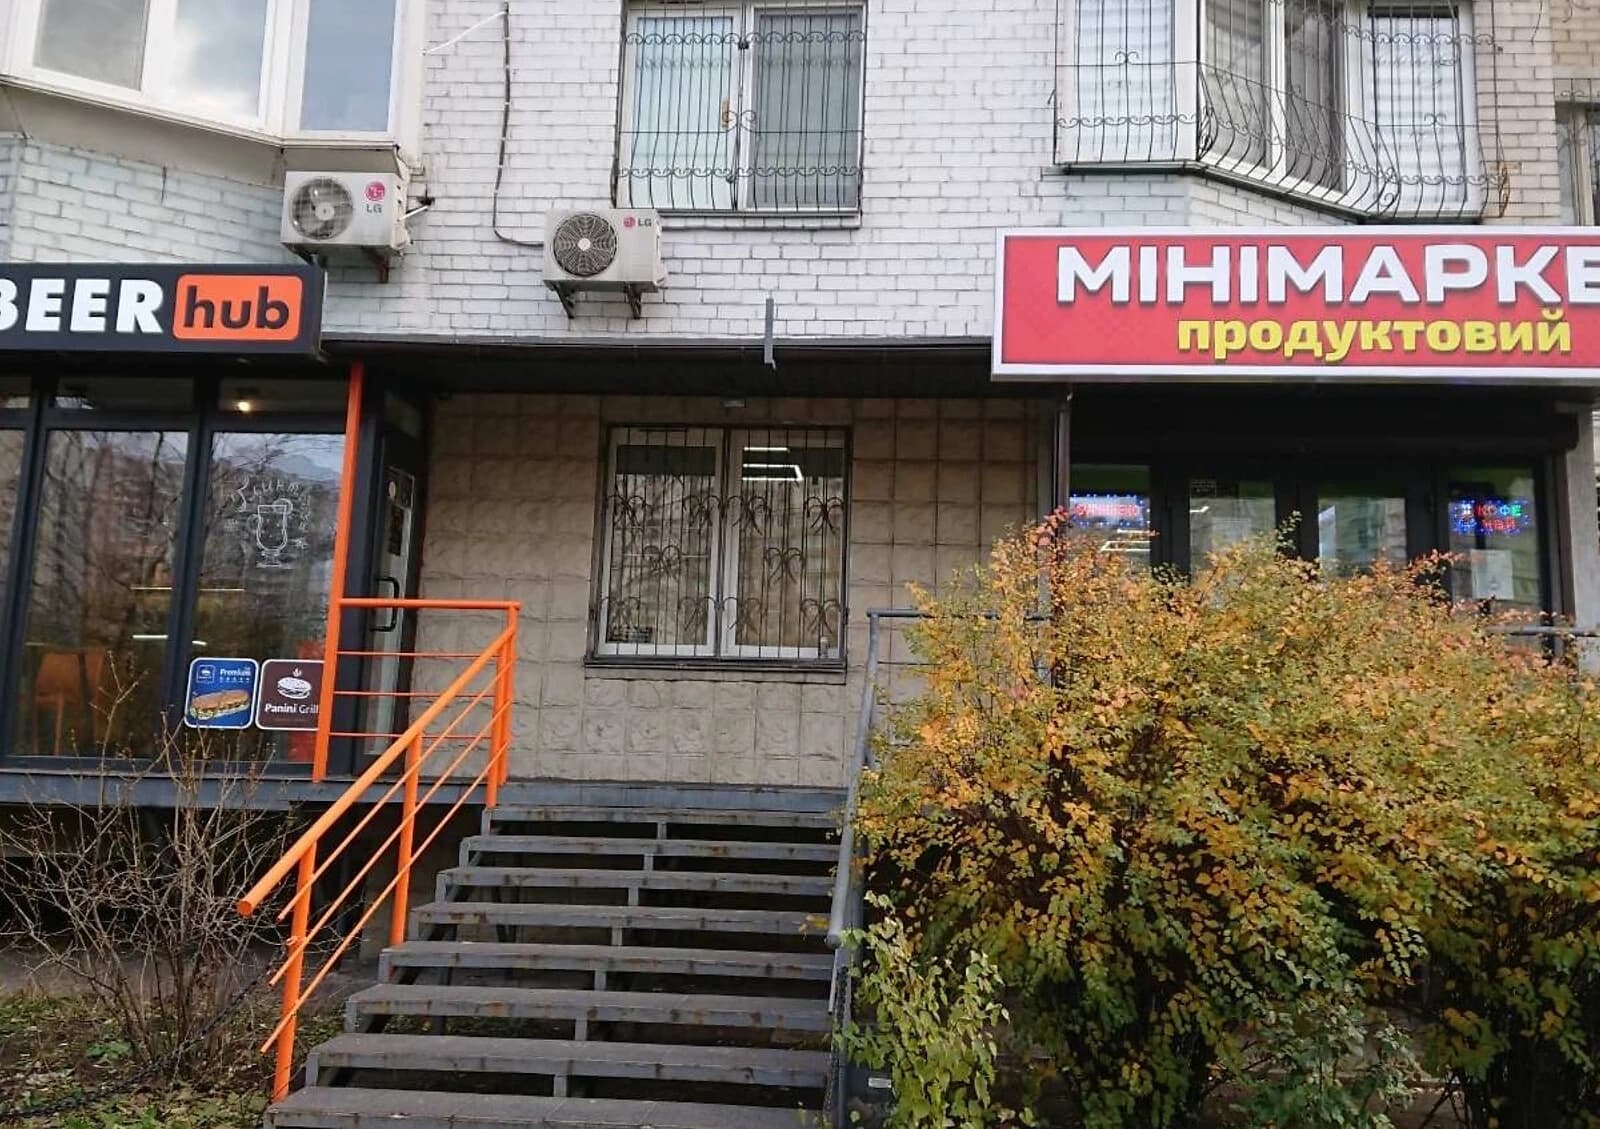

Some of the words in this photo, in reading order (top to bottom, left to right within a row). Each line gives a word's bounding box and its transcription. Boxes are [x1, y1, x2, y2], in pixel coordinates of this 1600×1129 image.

[366, 203, 382, 213] LG
[637, 218, 652, 227] LG
[1057, 244, 1600, 303] МІНІМАРКЕ
[183, 285, 290, 329] hub
[1178, 309, 1571, 362] продуктовий
[265, 703, 297, 713] Panini
[298, 704, 319, 714] Grill
